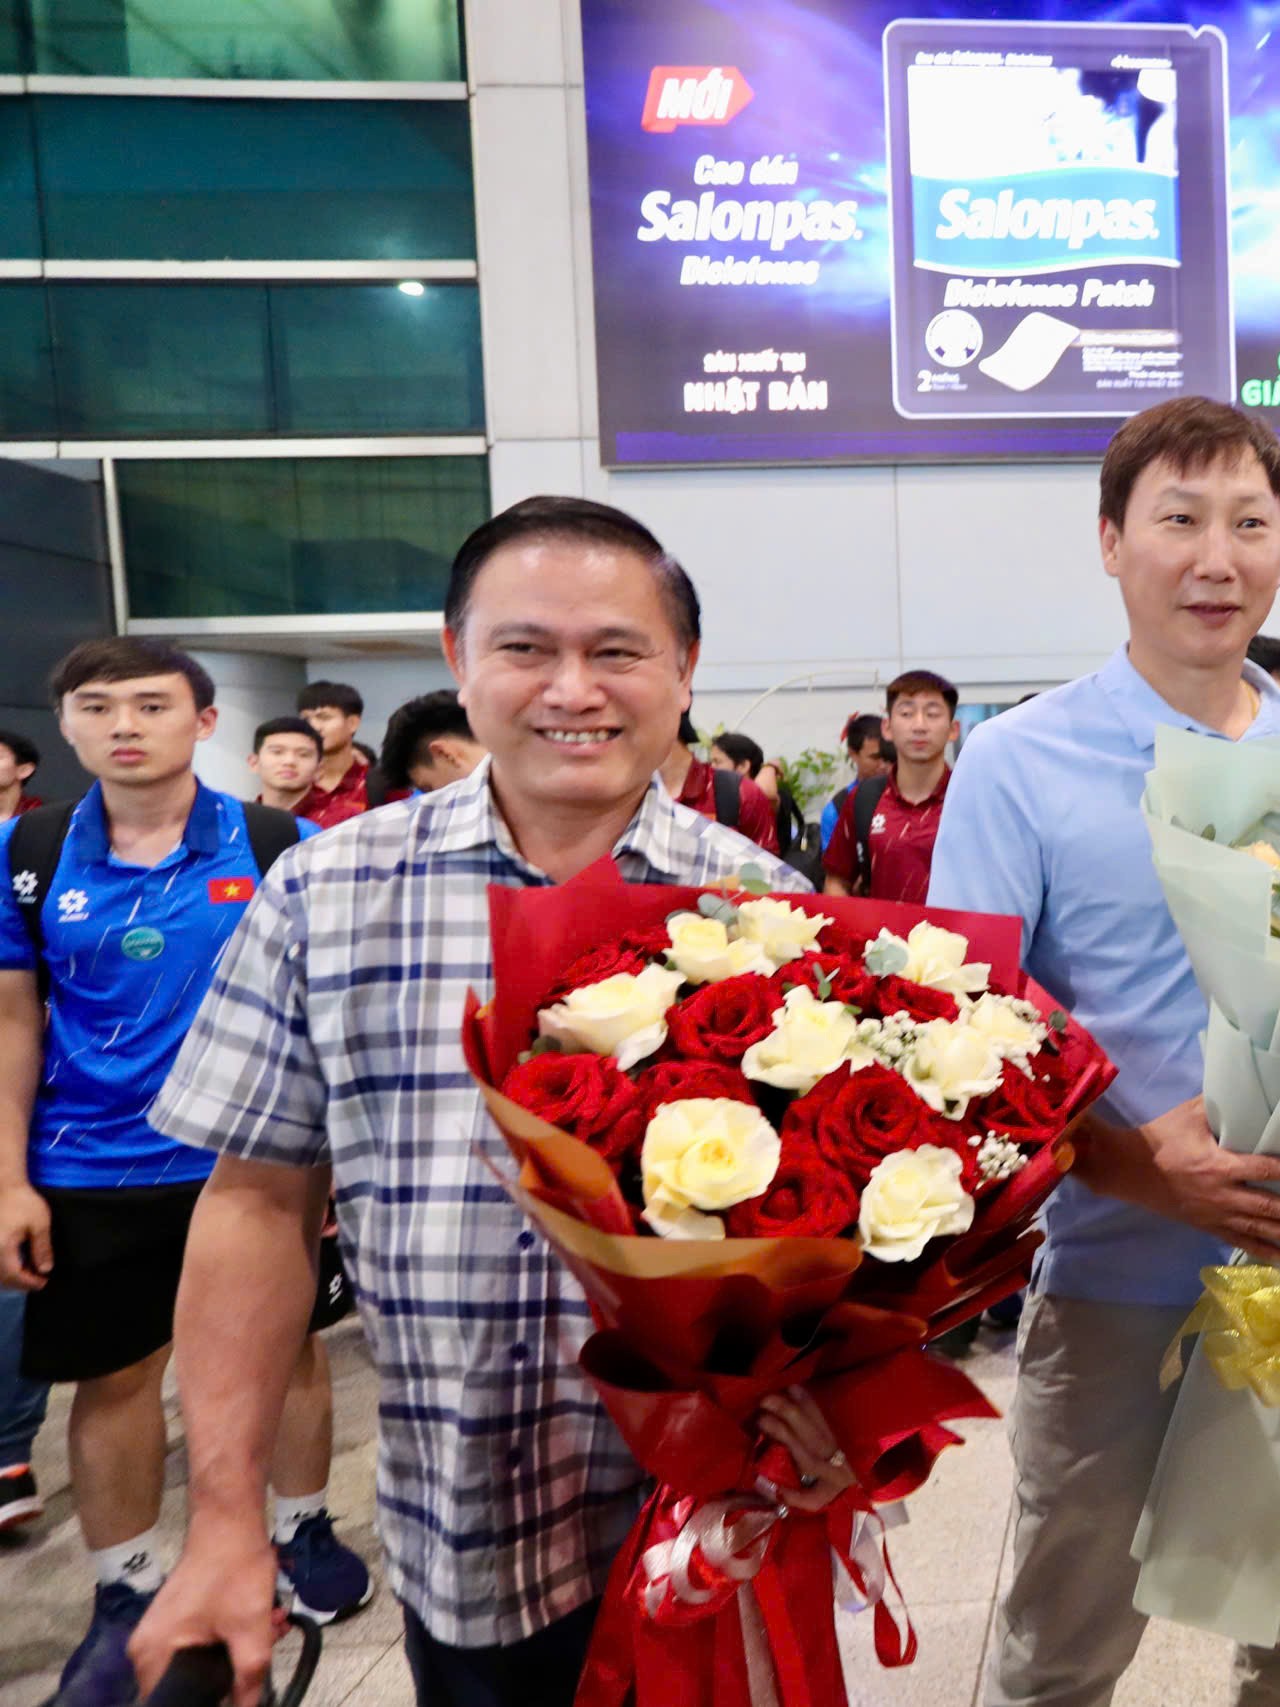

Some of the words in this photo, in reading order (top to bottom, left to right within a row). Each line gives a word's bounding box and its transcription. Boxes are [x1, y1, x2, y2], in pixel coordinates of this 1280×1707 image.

[656, 67, 734, 120] MỚI
[694, 154, 745, 186] Cao
[1080, 278, 1155, 307] Patch
[683, 376, 761, 415] NHẬT
[768, 374, 828, 411] BẢN
